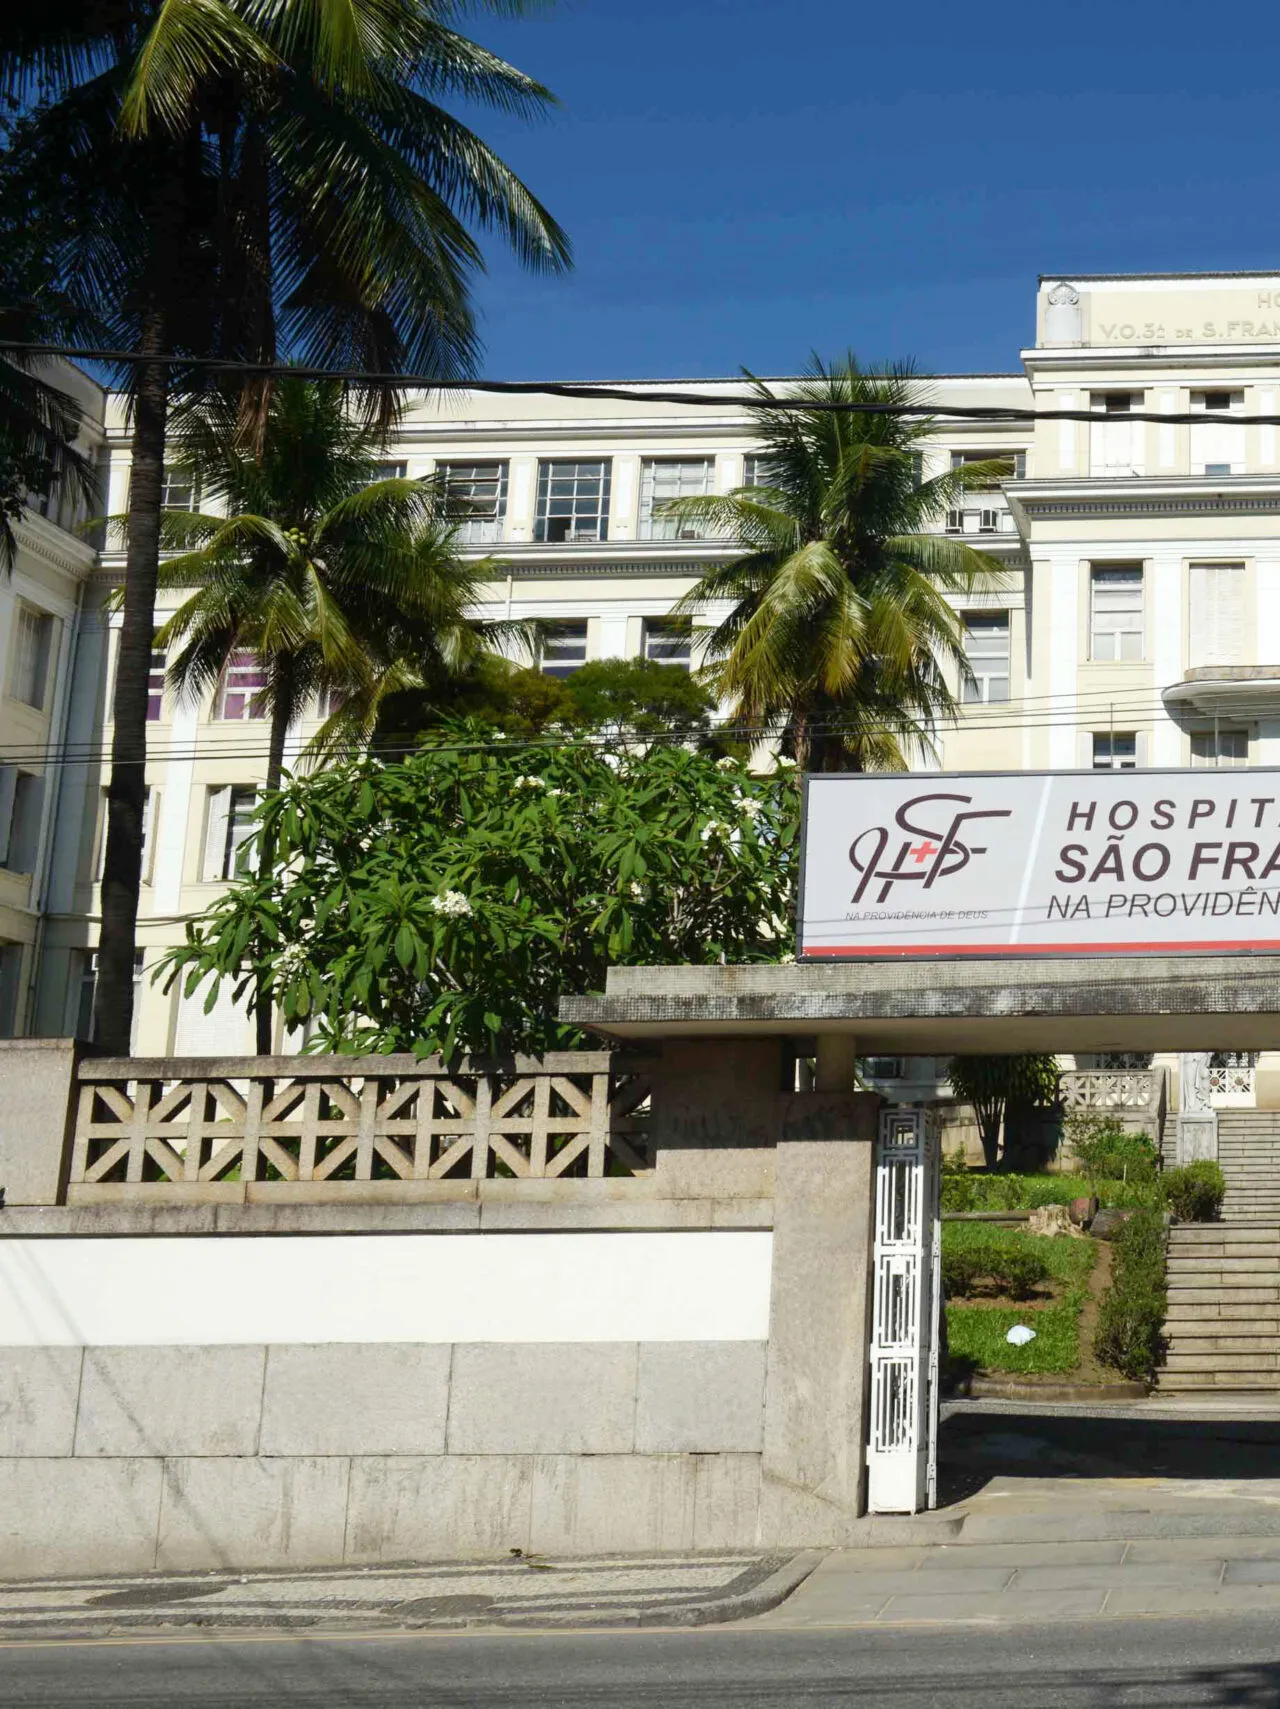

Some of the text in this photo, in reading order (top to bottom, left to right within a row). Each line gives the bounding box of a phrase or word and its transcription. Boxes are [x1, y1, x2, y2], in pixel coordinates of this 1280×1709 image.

[1174, 328, 1193, 339] DE
[1055, 835, 1170, 883] SÃO
[845, 909, 989, 921] NA PROVIDÊNCIA DE DEUS
[1047, 895, 1091, 919] NA
